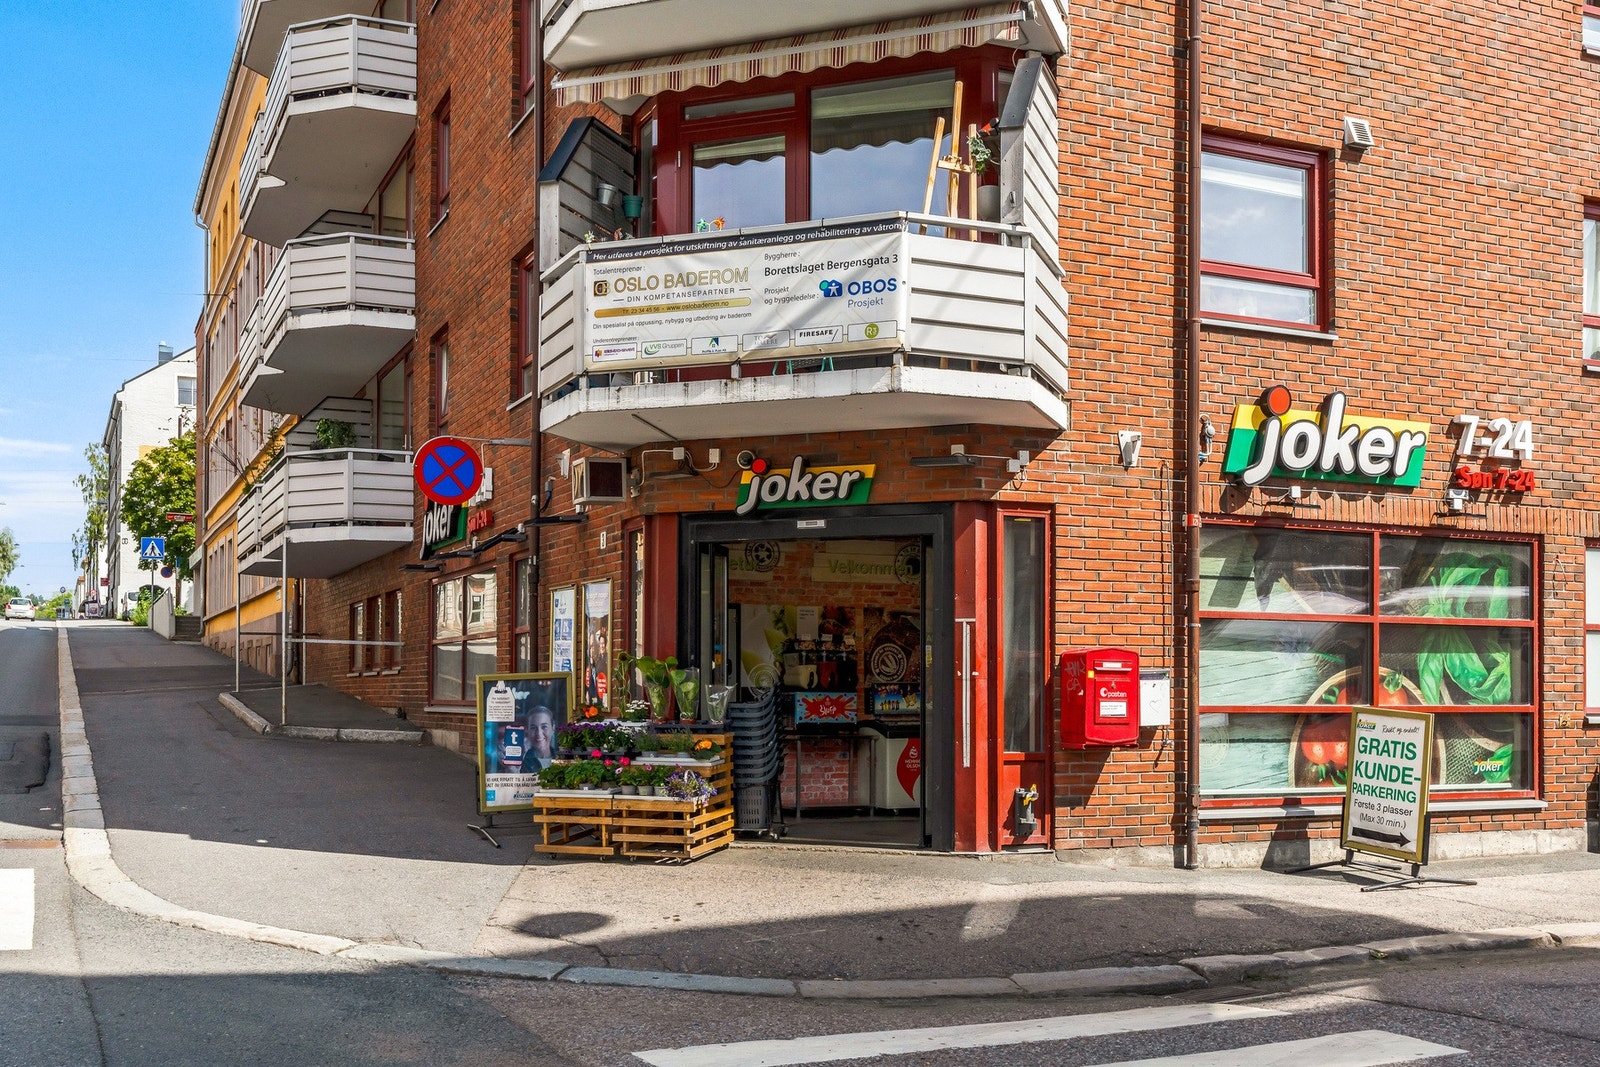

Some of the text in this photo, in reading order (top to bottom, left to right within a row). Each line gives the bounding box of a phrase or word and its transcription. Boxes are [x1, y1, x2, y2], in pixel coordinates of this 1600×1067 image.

[593, 252, 606, 260] Her
[608, 250, 633, 260] utføres
[643, 246, 673, 257] prosjekt
[686, 241, 727, 251] utskiftning
[739, 235, 794, 247] sanitæranlegg
[795, 233, 806, 242] og
[807, 227, 860, 239] rehabilitering
[764, 254, 899, 277] Borettslaget Bergensgata 3
[614, 275, 660, 294] OSLO
[664, 266, 749, 289] BADEROM
[847, 277, 898, 296] OBOS
[644, 287, 735, 301] KOMPETANSEPARTNER
[764, 286, 790, 295] Prosjekt
[666, 300, 730, 311] www.oslobaderom.no
[848, 297, 885, 308] Prosjekt
[603, 321, 627, 329] spesialist
[693, 314, 719, 322] utbedring
[727, 311, 752, 319] baderom
[799, 329, 834, 338] FIRESAFE
[1242, 384, 1427, 487] joker
[1453, 414, 1535, 460] 7-24
[736, 455, 861, 515] joker
[1456, 466, 1536, 491] Søn 7-24
[828, 558, 913, 577] Velkommen
[1107, 691, 1127, 699] posten
[1357, 736, 1417, 761] GRATIS
[1354, 760, 1421, 786] KUNDE-
[1474, 758, 1502, 775] joker
[1352, 782, 1417, 804] PARKERING
[1353, 799, 1413, 817] Første 3 plasser
[1360, 812, 1407, 830] (Max 30 min.)
